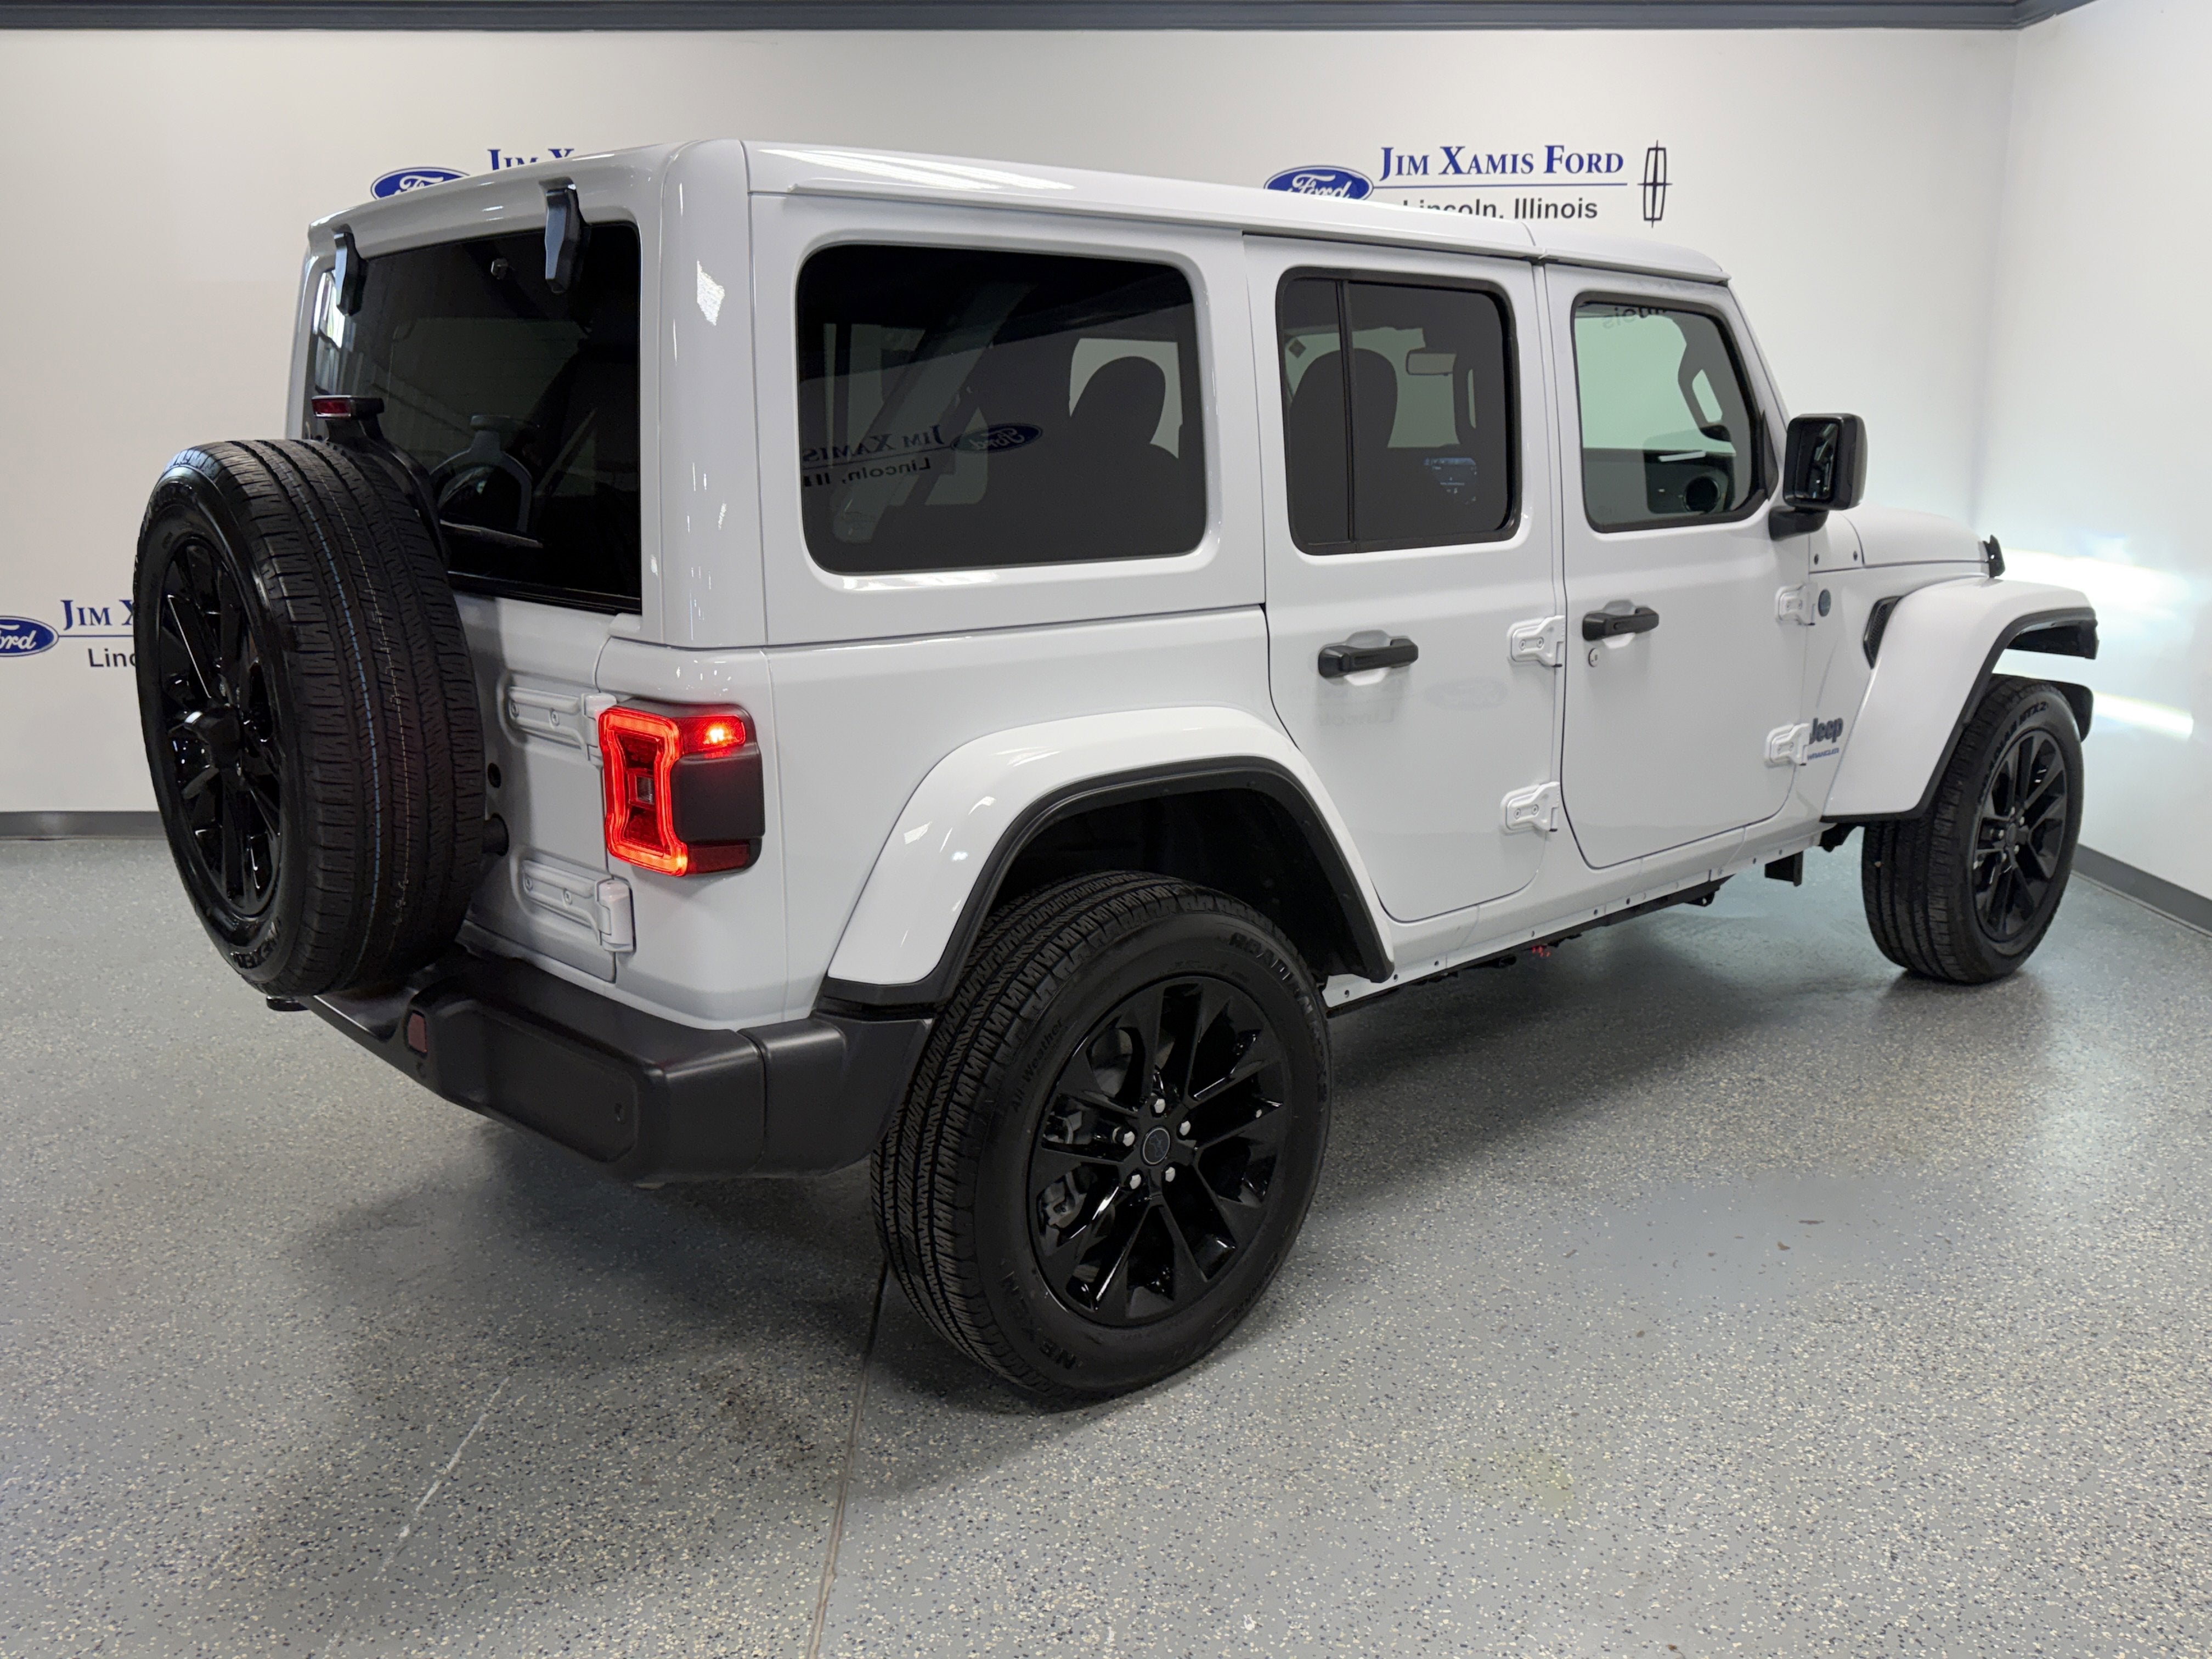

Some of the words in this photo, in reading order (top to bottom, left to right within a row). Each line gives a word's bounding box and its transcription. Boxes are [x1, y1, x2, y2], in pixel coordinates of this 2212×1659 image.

[1379, 147, 1429, 182] JIM
[1438, 145, 1534, 175] XAMIS
[1543, 145, 1624, 174] FORD
[1514, 198, 1598, 219] Illinois
[1809, 718, 1843, 744] Jeep
